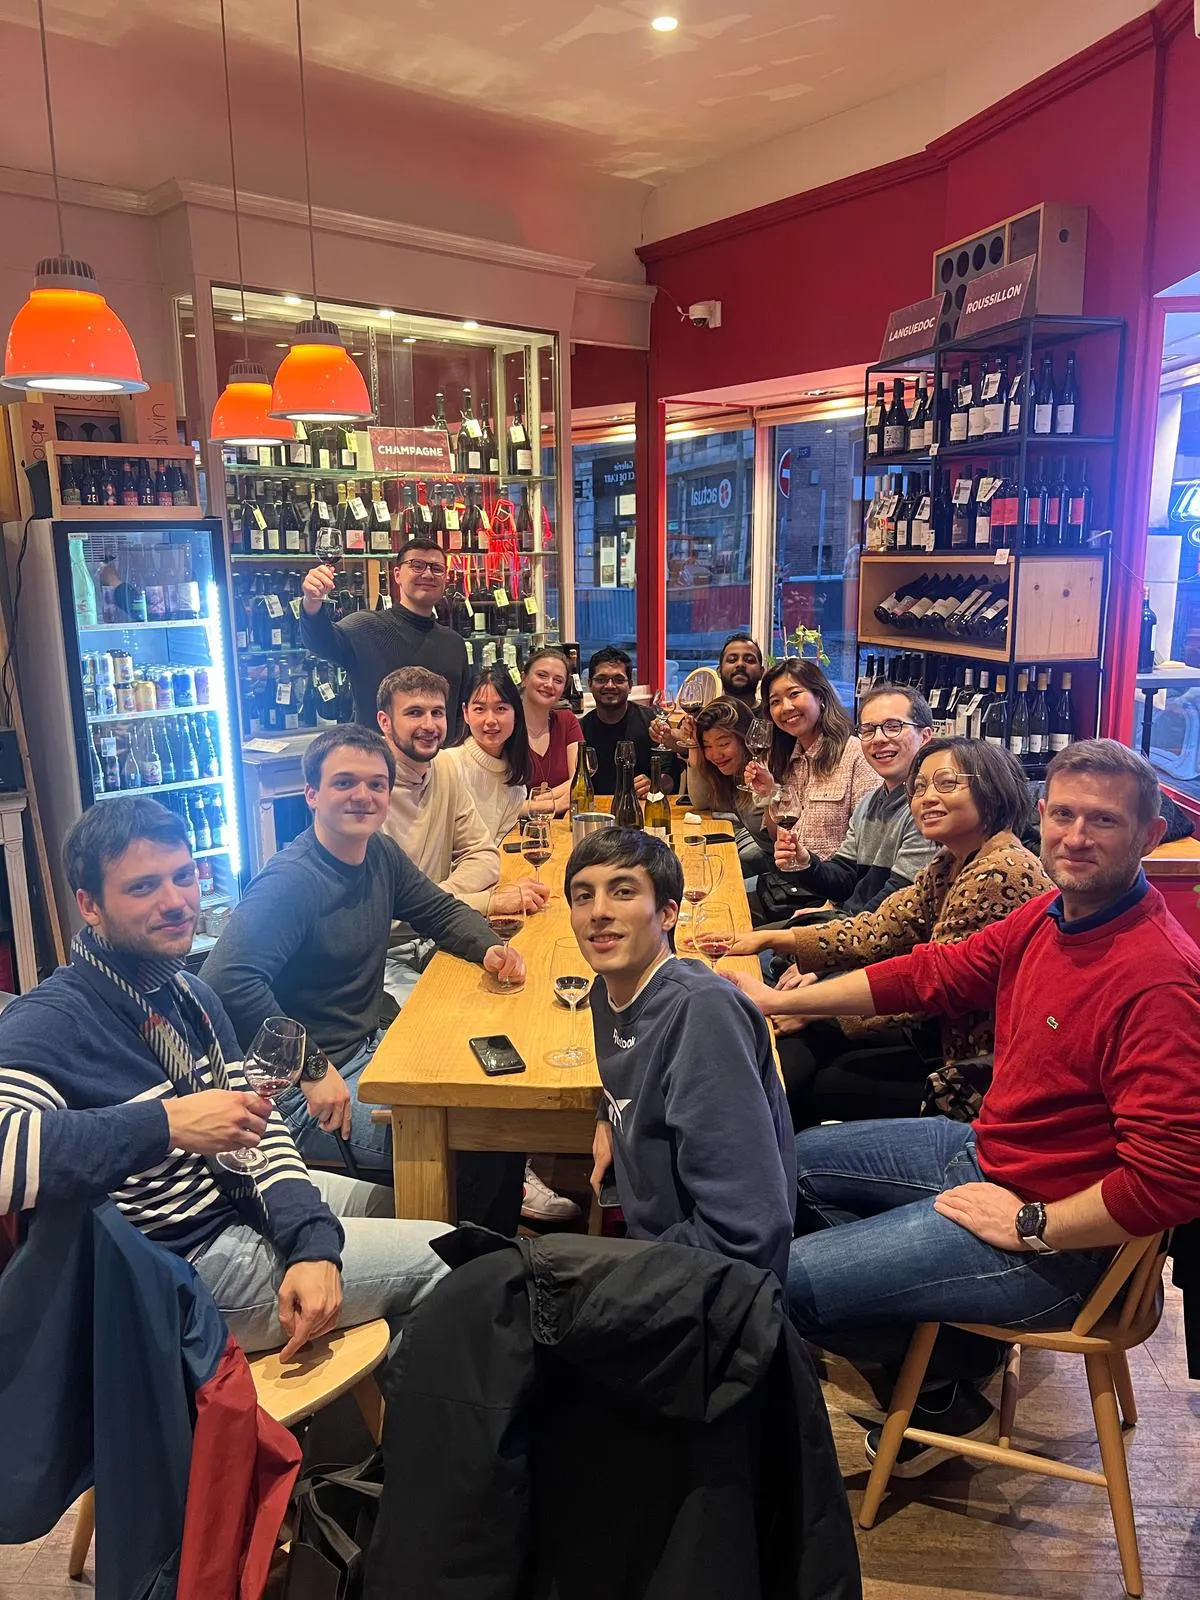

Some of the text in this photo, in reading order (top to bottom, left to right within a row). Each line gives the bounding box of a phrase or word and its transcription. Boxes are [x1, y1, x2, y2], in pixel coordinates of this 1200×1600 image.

[966, 283, 1022, 314] ROUSSILLON
[888, 317, 936, 342] LANGUEDOC
[377, 445, 444, 457] CHAMPAGNE
